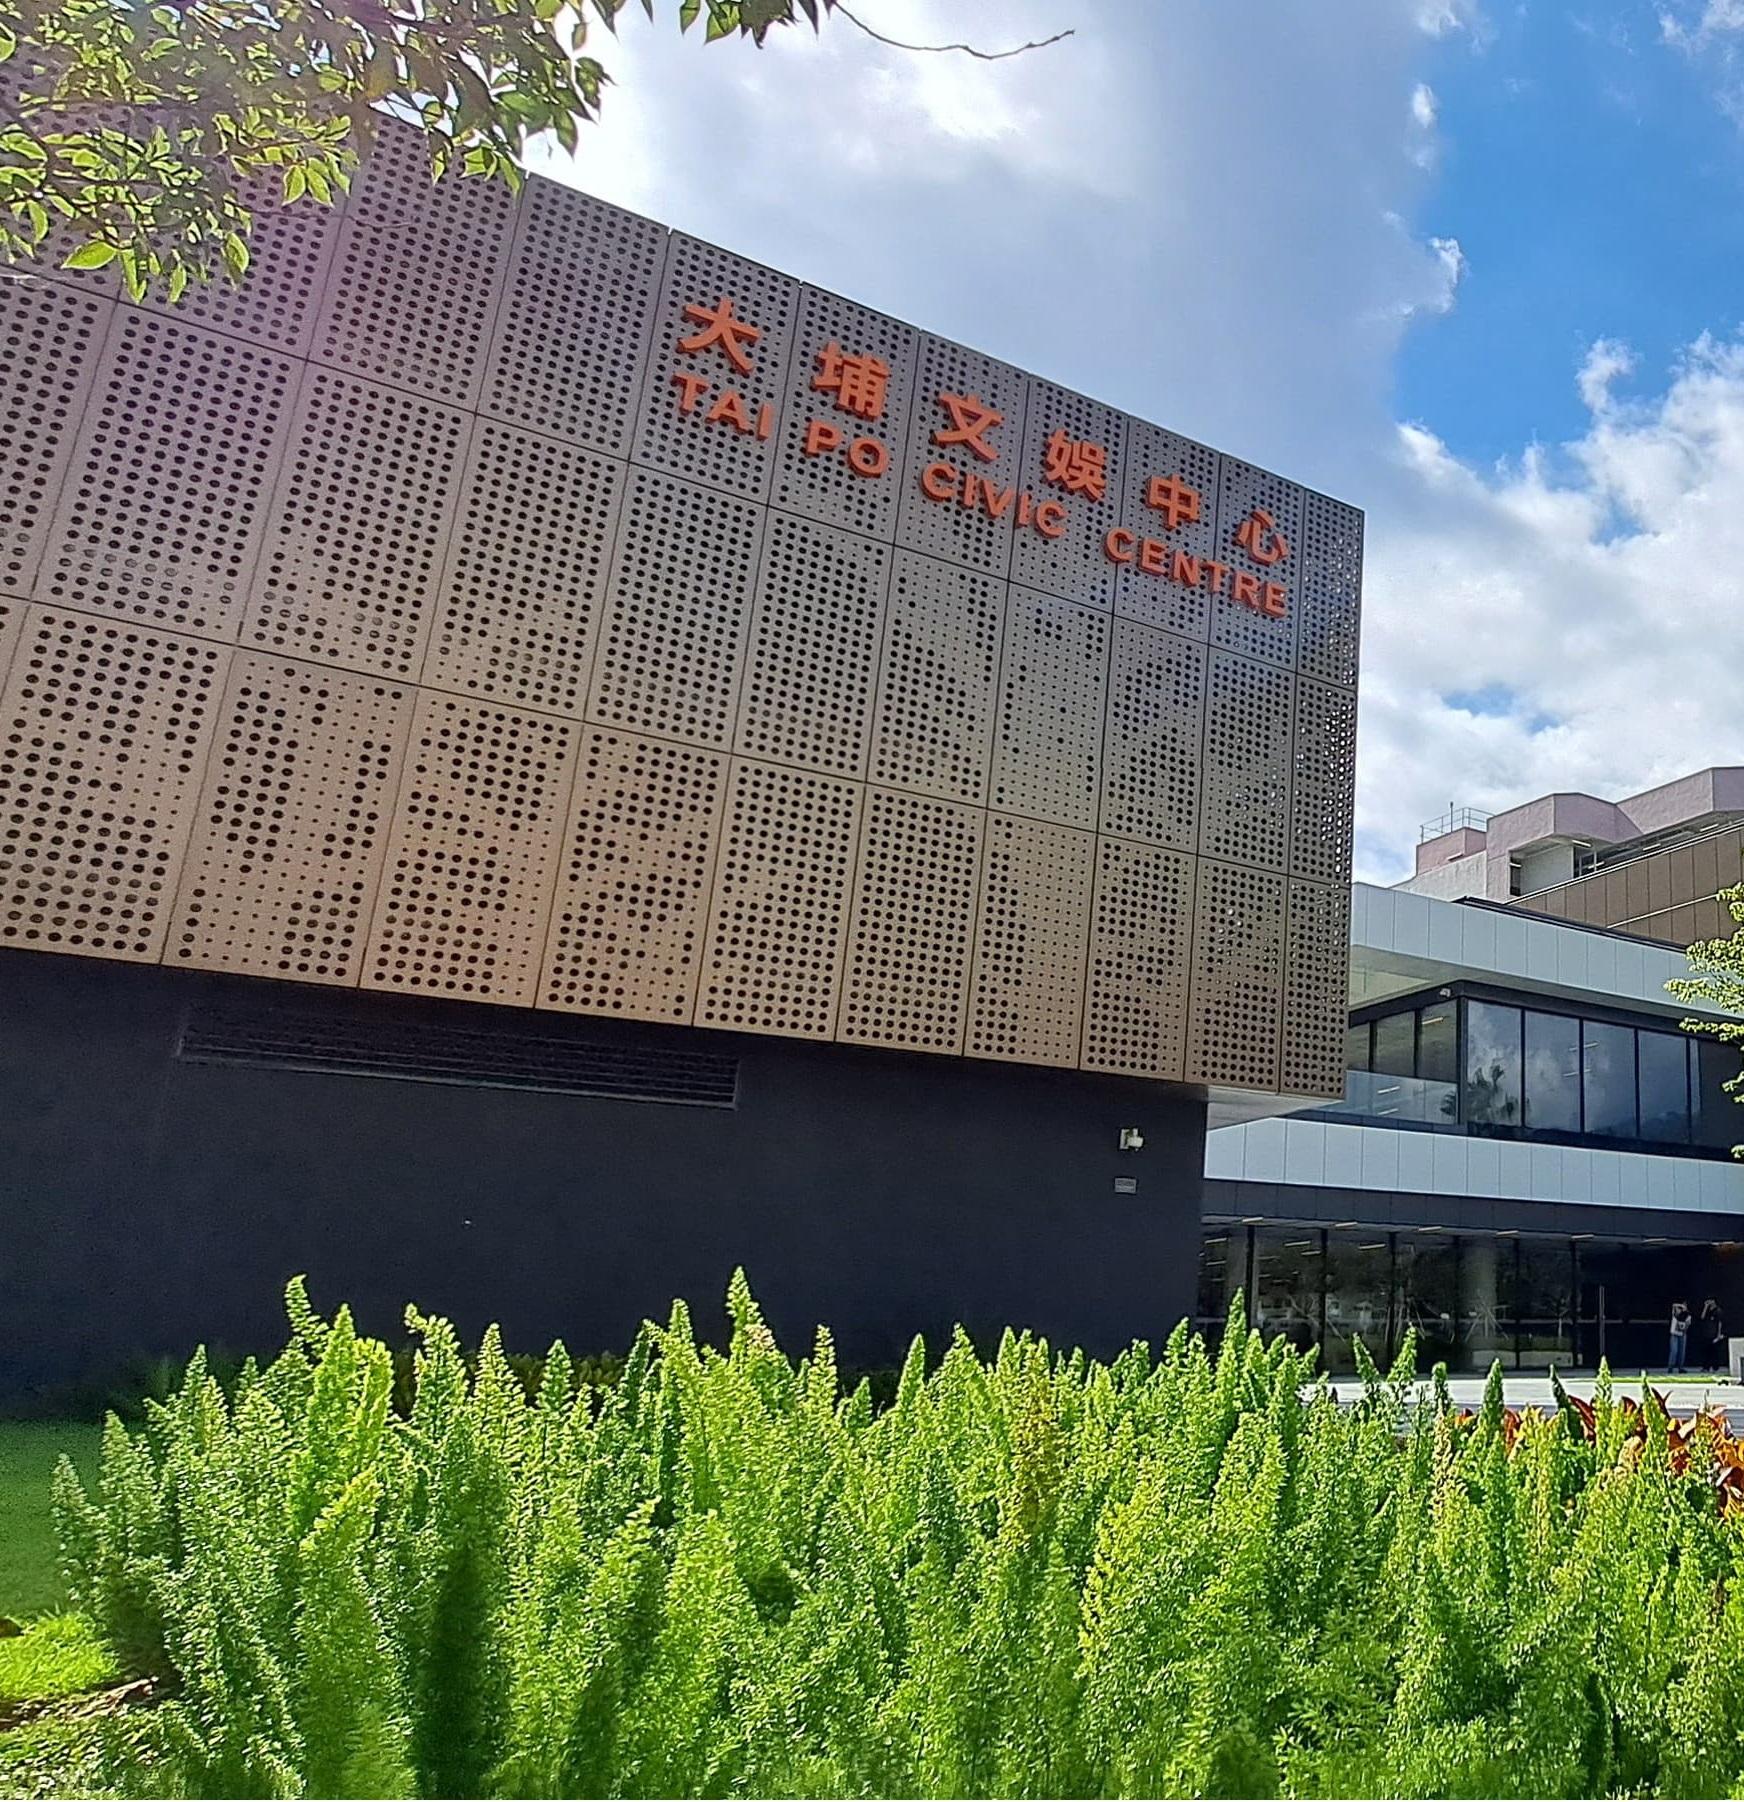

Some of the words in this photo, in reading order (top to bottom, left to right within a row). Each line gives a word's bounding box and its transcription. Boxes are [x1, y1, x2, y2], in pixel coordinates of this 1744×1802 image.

[671, 373, 773, 439] TAI
[804, 419, 889, 477] PO
[920, 461, 1067, 538] CIVIC
[1104, 527, 1288, 617] CENTRE
[679, 298, 1289, 566] 大埔文娛中心
